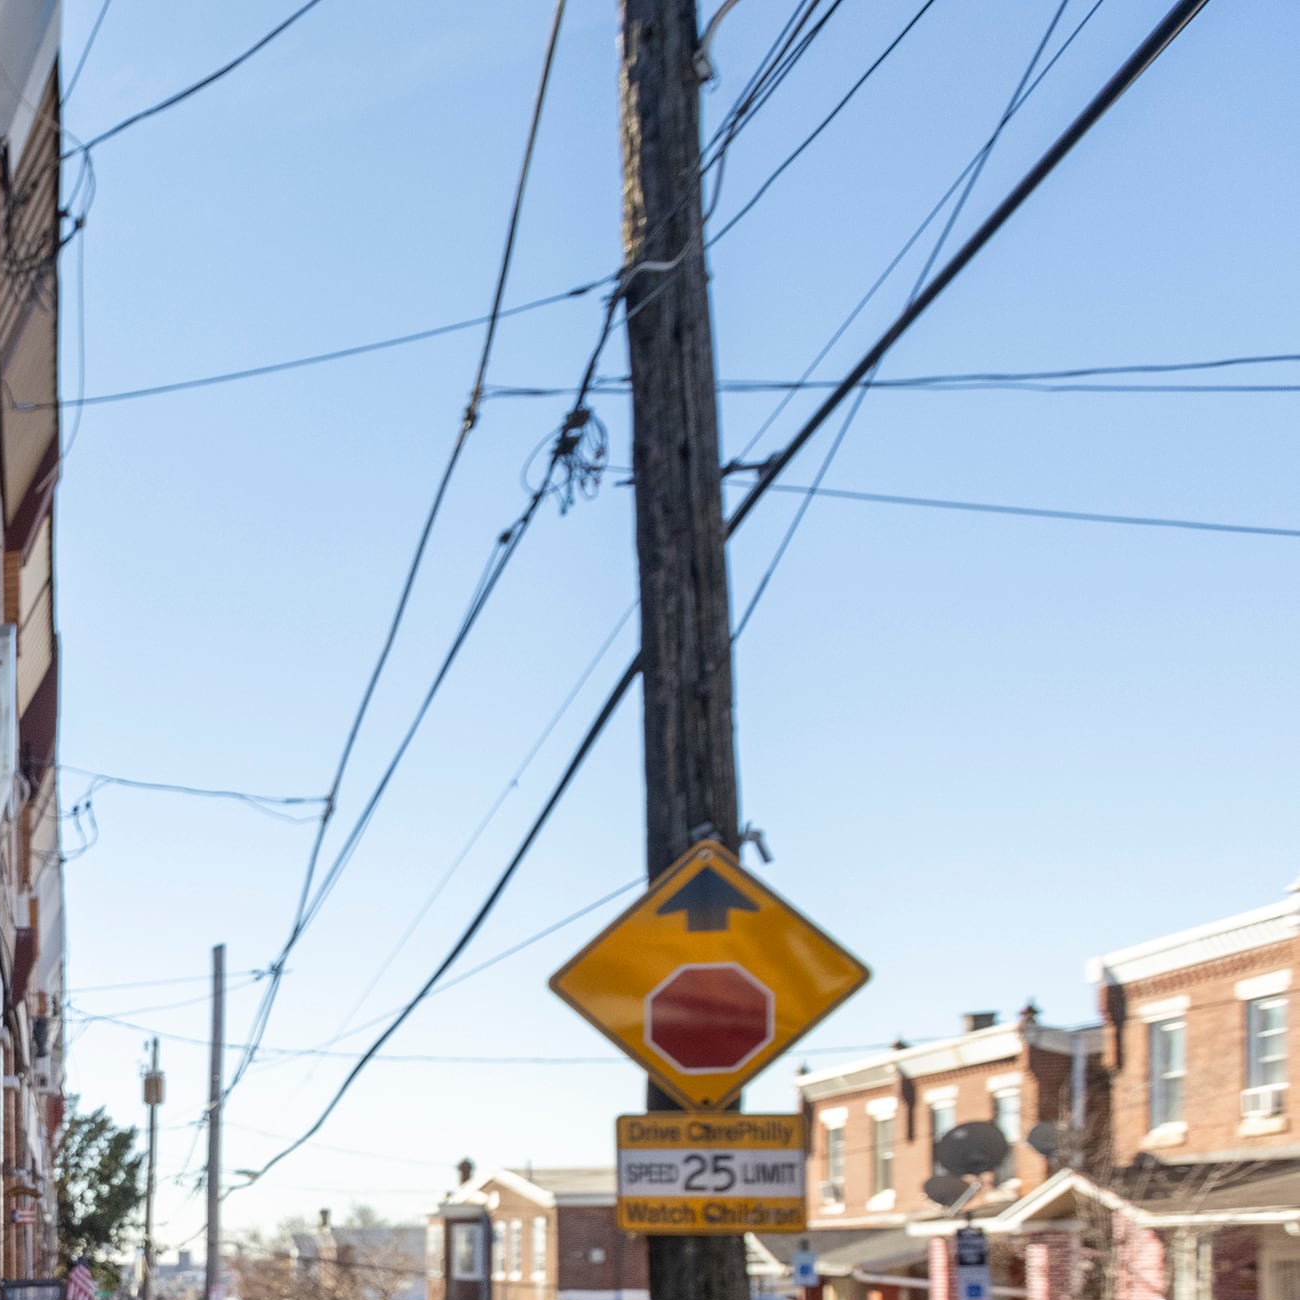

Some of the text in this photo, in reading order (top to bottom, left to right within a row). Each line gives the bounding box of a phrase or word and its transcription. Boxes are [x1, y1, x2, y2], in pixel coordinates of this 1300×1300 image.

[629, 1121, 793, 1144] Drive CarePhilly
[626, 1153, 798, 1192] SPEED 25 LIMIT
[626, 1201, 799, 1226] Watch Children
